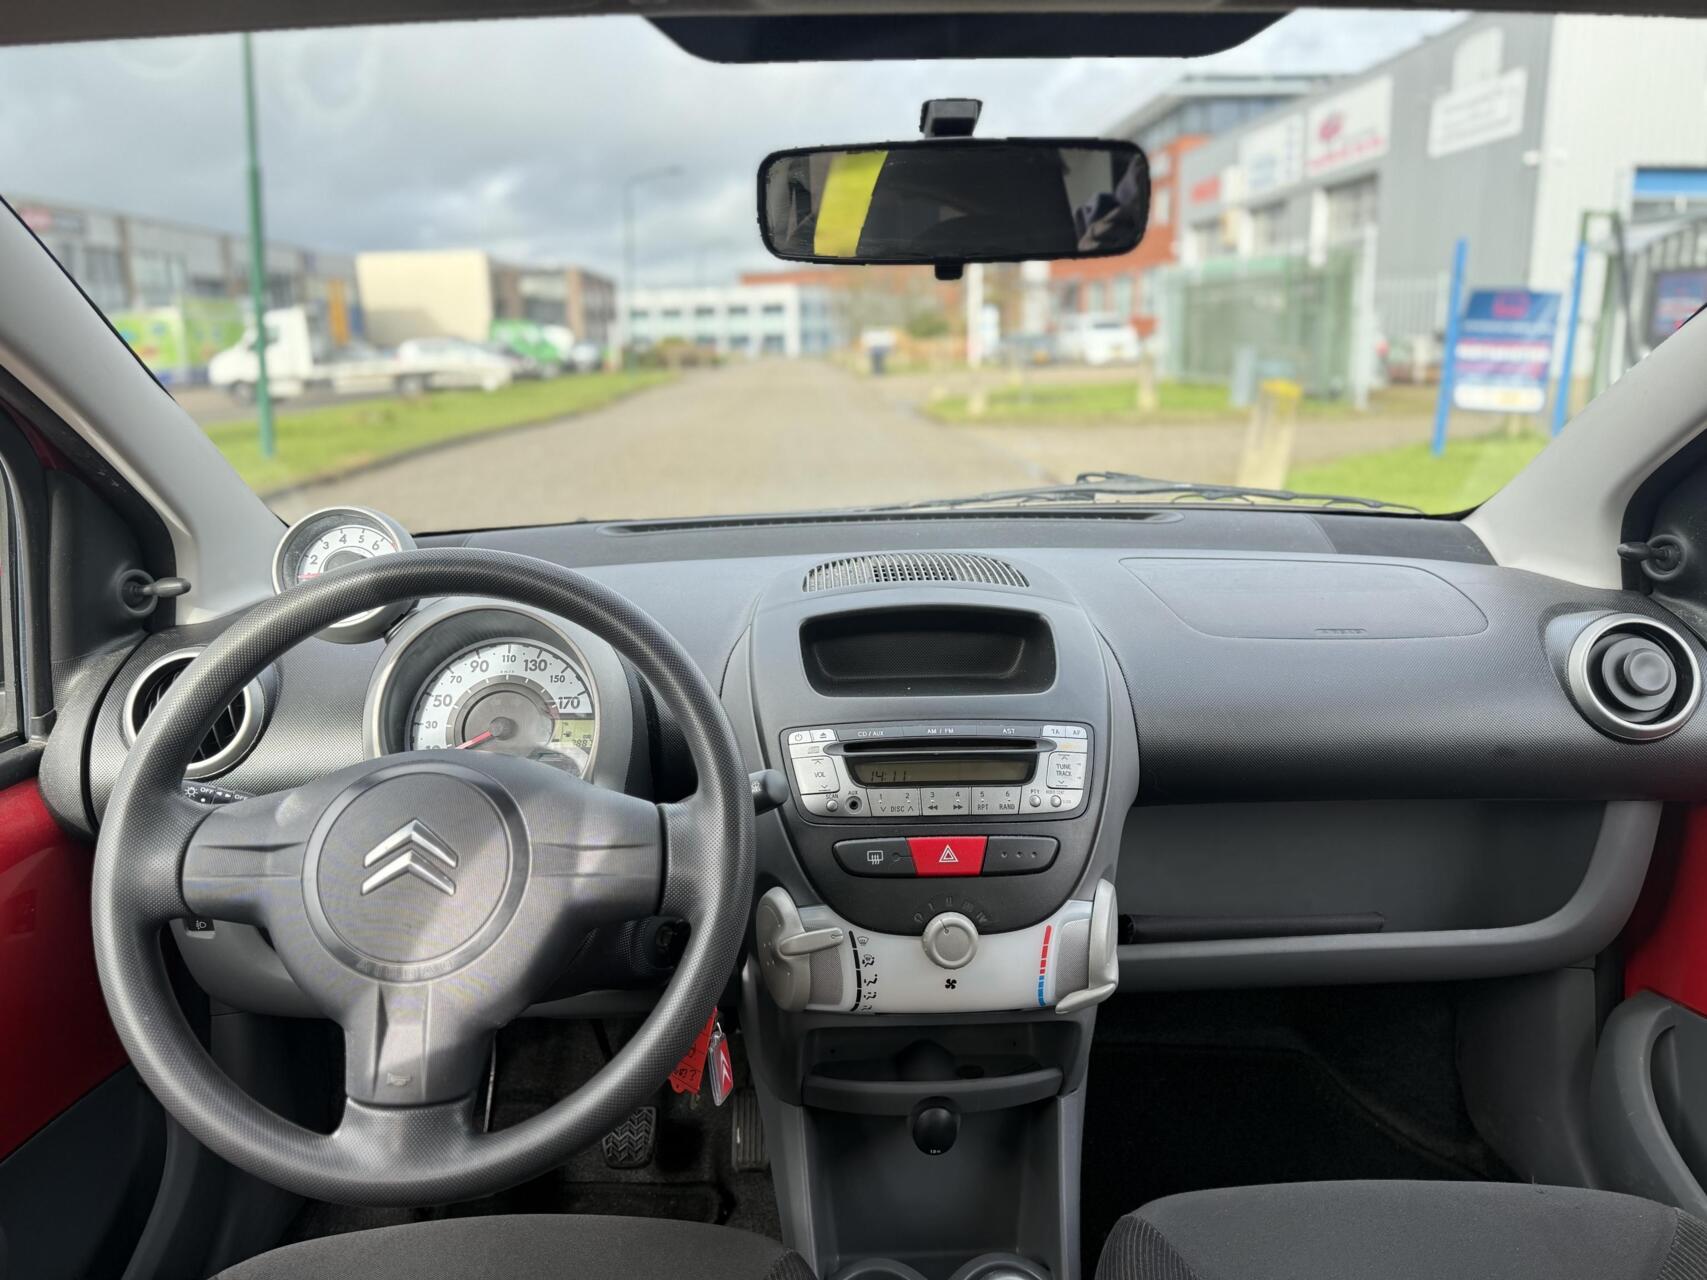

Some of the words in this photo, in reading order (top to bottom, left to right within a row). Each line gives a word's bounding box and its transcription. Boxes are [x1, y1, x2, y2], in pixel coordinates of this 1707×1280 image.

[339, 534, 347, 545] 4
[358, 534, 365, 544] 5
[322, 541, 330, 550] 3
[372, 540, 380, 550] 6
[310, 554, 318, 565] 2
[502, 654, 517, 663] 110
[470, 659, 489, 673] 90
[523, 658, 548, 672] 130
[449, 675, 462, 684] 70
[550, 674, 566, 683] 150
[432, 694, 453, 708] 50
[558, 696, 580, 709] 170
[425, 720, 438, 729] 30
[871, 770, 907, 782] 14:11
[200, 786, 214, 795] OFF
[234, 793, 249, 801] OFF
[890, 805, 905, 813] DISC
[977, 803, 989, 811] RPT
